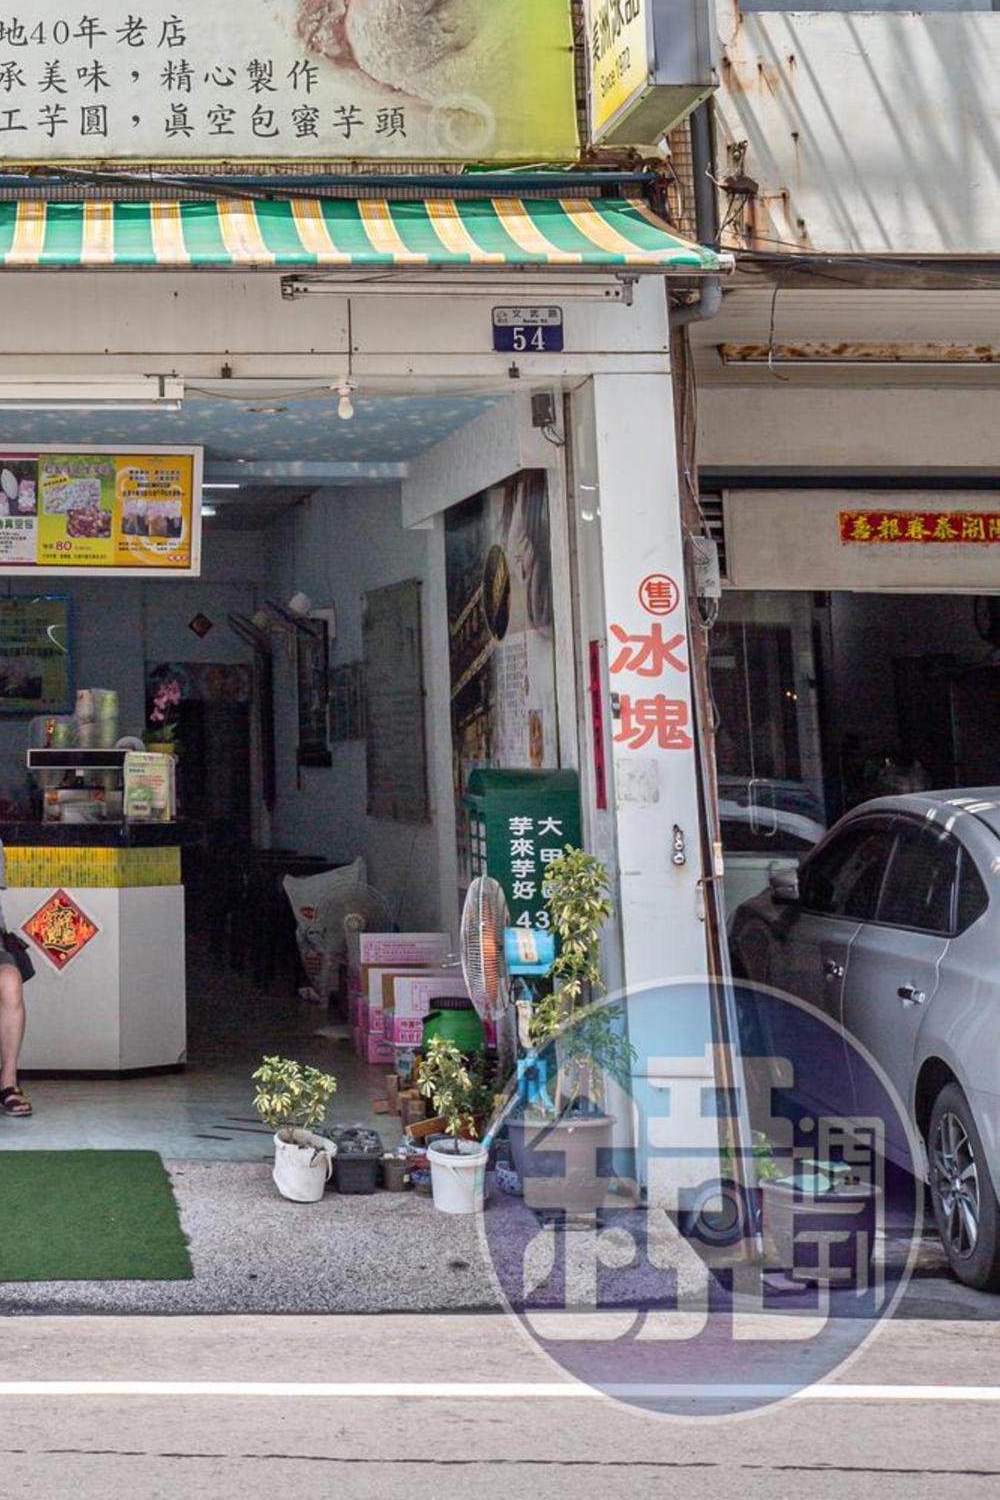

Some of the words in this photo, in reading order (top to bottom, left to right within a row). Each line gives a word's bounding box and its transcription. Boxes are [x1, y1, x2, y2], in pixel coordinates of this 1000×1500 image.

[513, 326, 546, 351] 54
[609, 622, 693, 751] 冰塊
[508, 816, 537, 900] 芋來芋好
